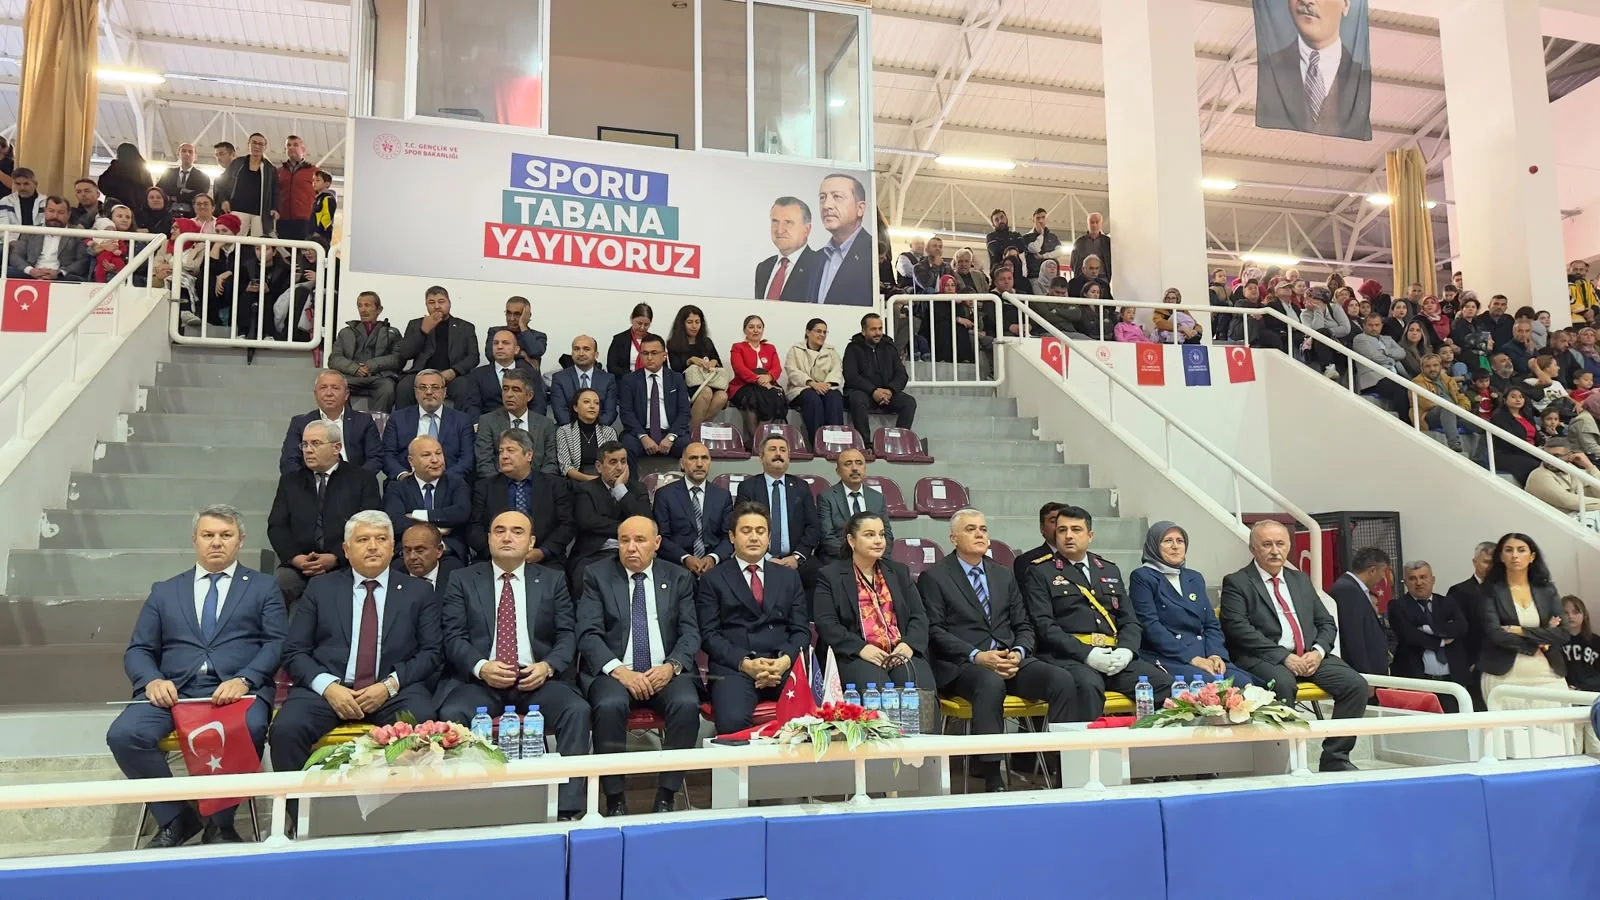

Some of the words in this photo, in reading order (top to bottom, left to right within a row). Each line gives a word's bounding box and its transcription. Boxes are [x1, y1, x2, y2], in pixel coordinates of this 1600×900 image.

[418, 143, 448, 152] GENÇLİK
[423, 151, 459, 159] BAKANLIĞI
[524, 159, 648, 202] SPORU
[513, 195, 665, 236] TABANA
[490, 226, 695, 275] YAYIYORUZ
